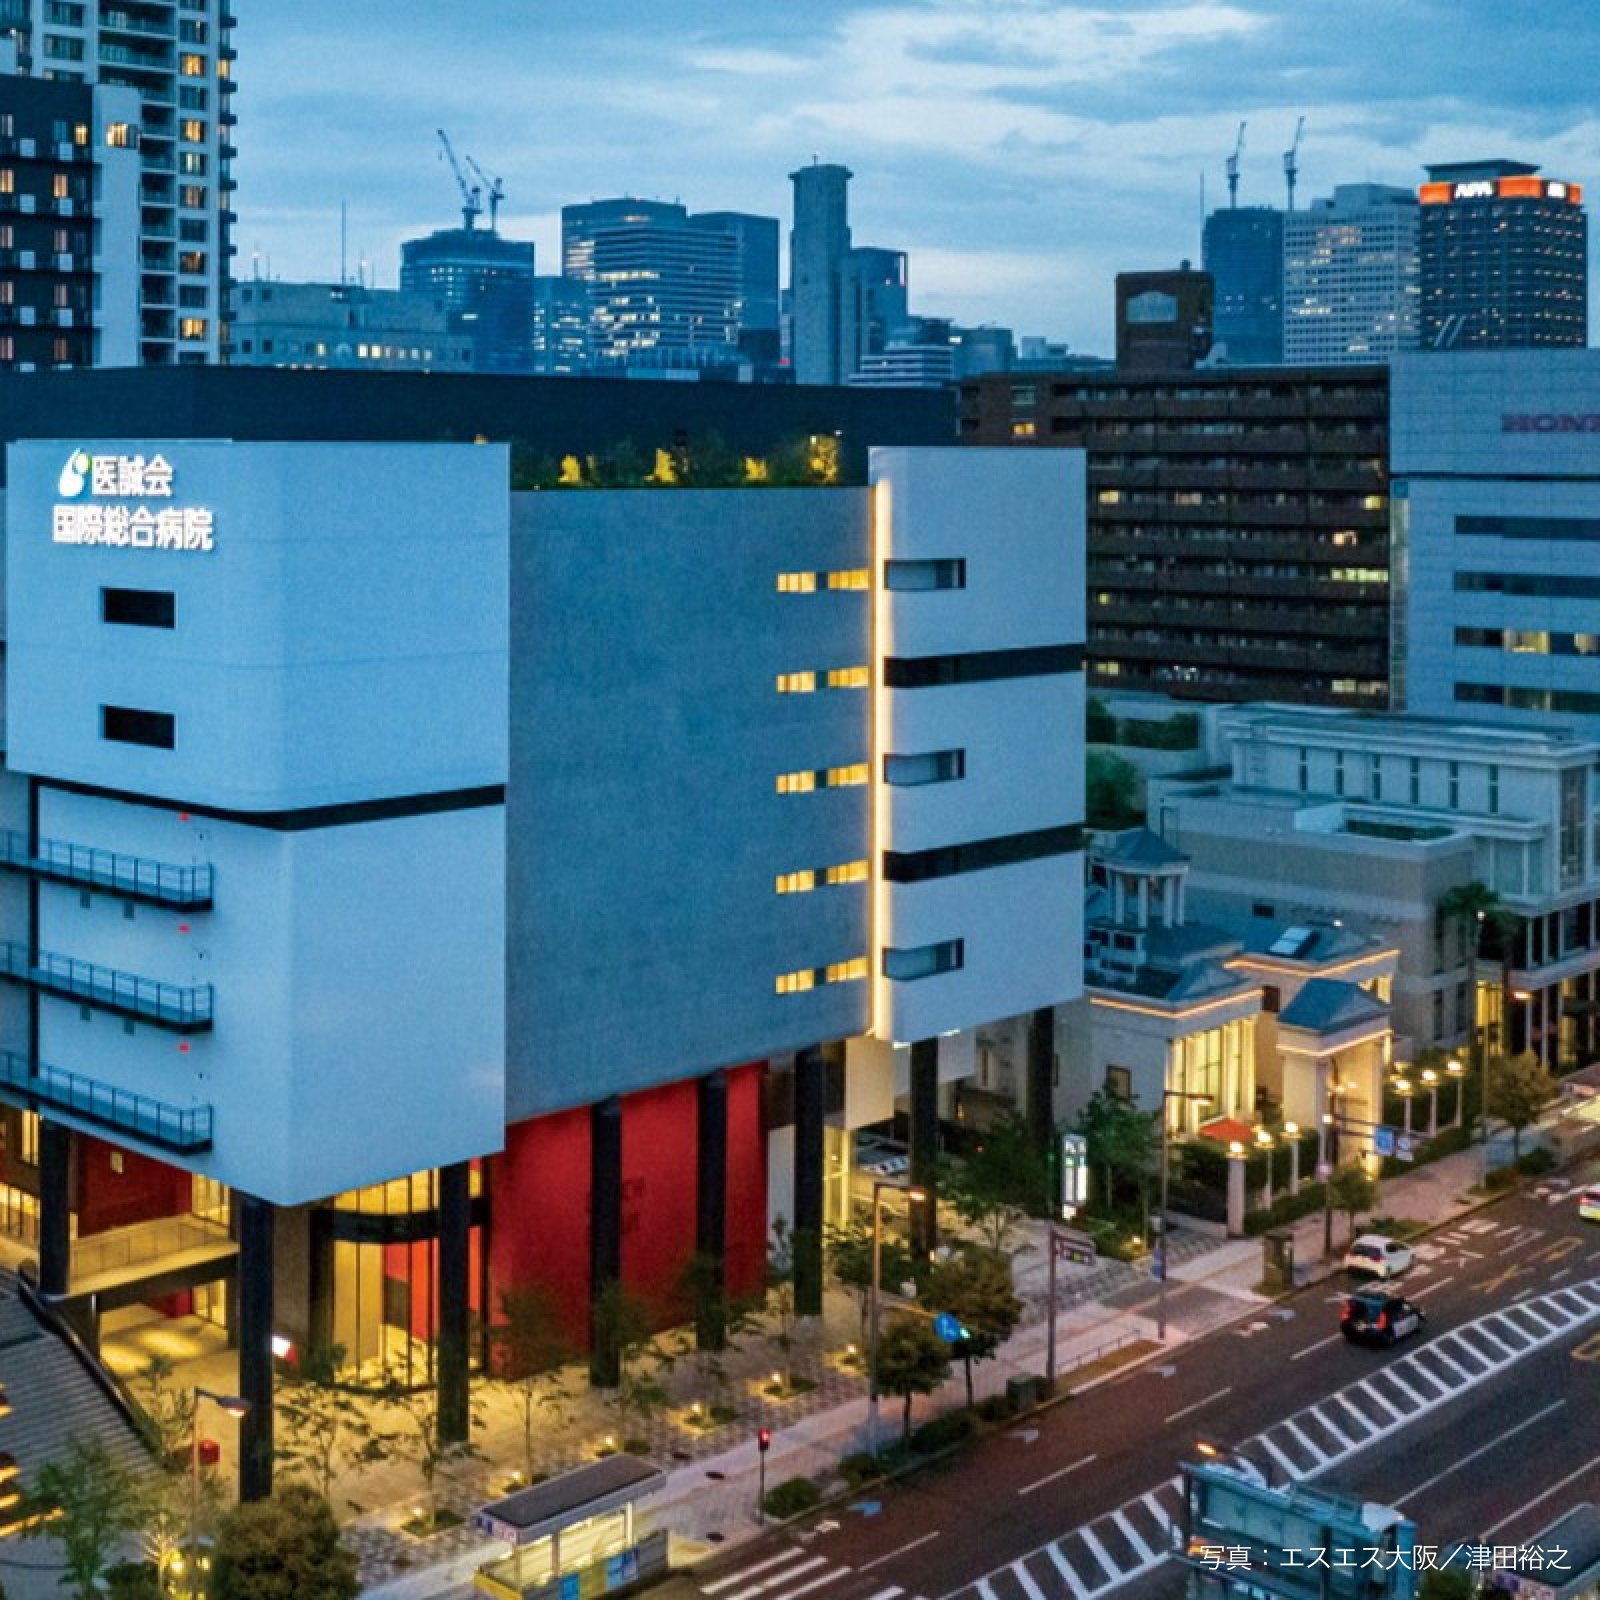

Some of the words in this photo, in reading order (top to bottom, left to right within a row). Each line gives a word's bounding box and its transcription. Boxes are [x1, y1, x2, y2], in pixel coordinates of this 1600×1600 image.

[91, 454, 173, 496] 医誠会
[53, 503, 214, 550] 国際総合病院
